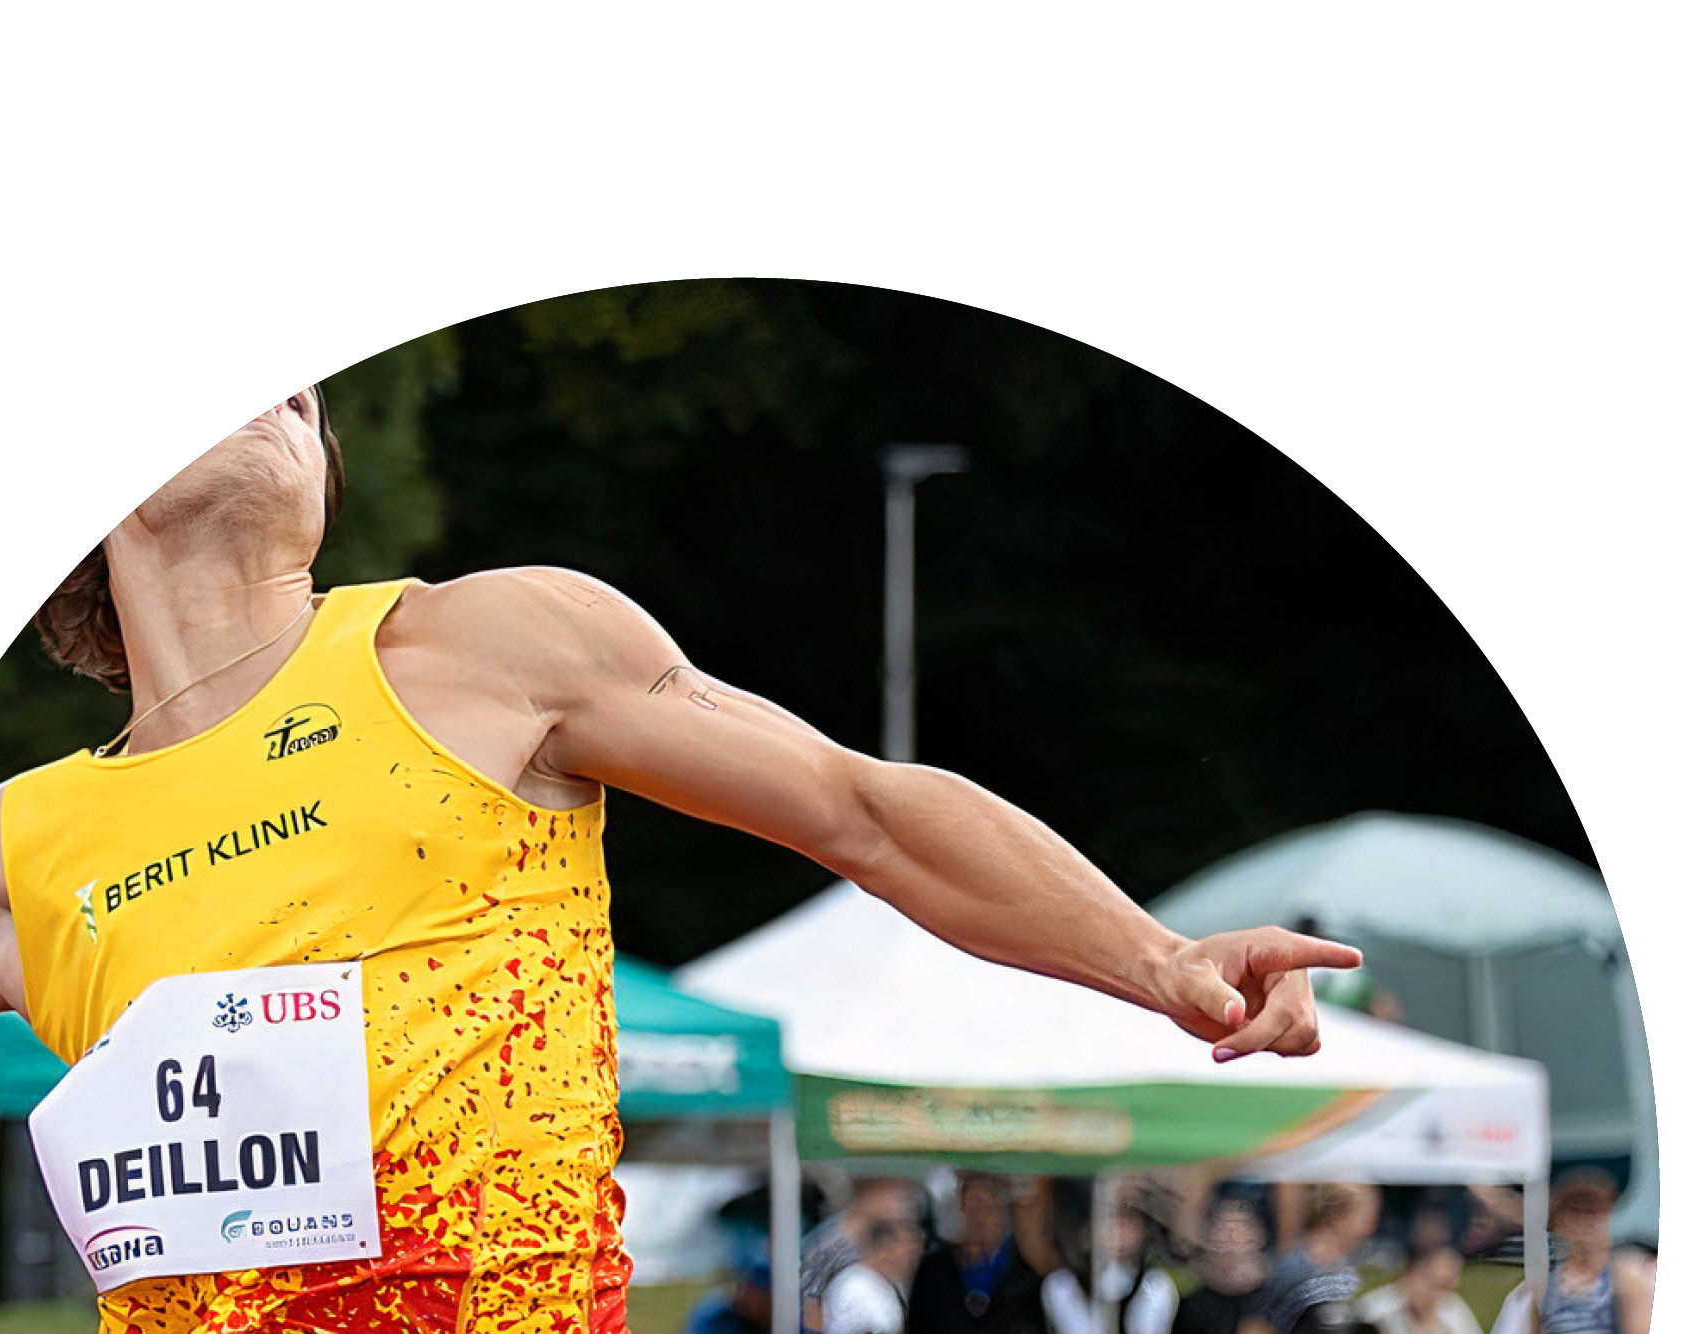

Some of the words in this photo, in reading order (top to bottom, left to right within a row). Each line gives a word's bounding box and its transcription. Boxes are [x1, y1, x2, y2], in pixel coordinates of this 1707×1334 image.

[105, 847, 194, 914] BERIT
[206, 800, 328, 867] KLINIK
[261, 989, 341, 1024] UBS
[156, 1054, 222, 1123] 64
[77, 1130, 321, 1214] DEILLON
